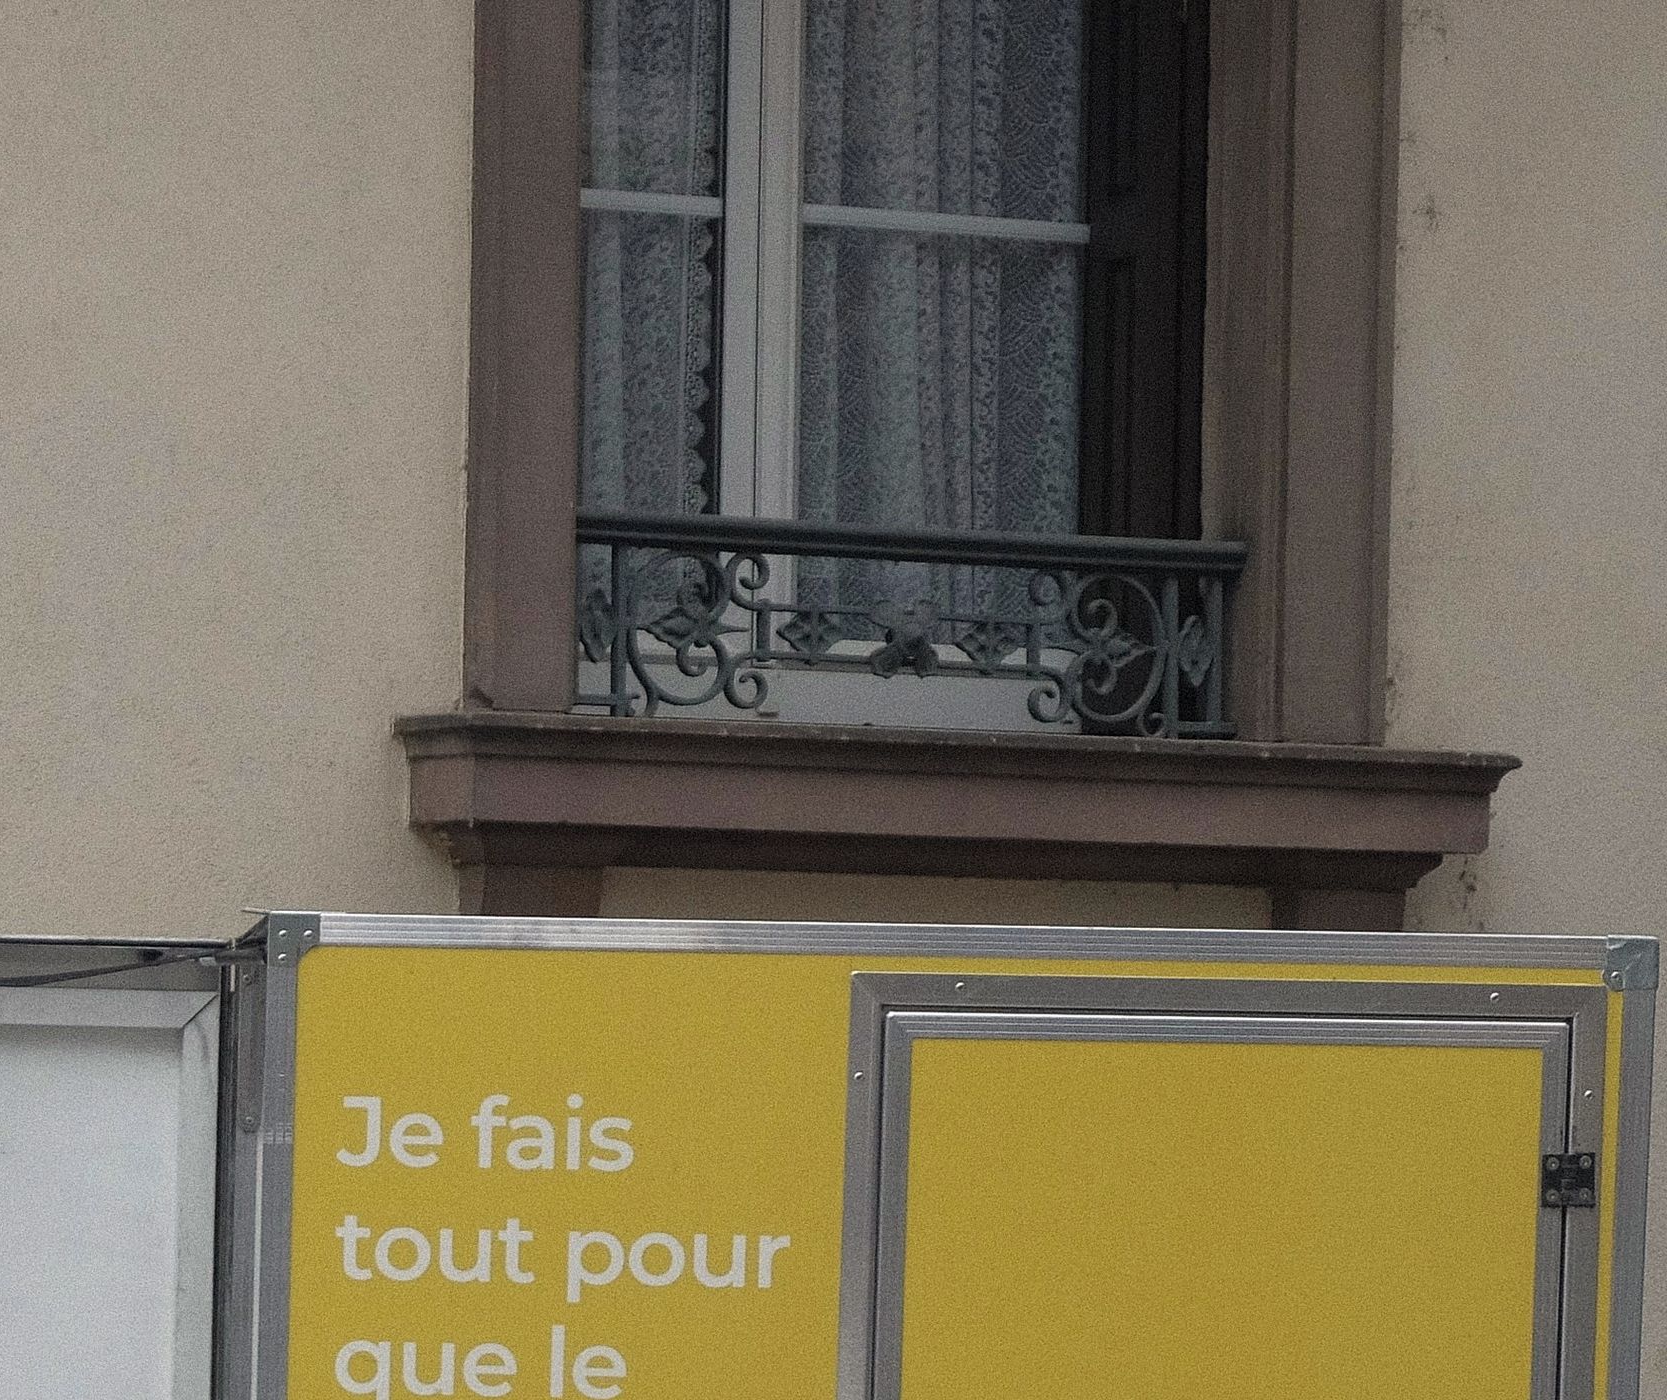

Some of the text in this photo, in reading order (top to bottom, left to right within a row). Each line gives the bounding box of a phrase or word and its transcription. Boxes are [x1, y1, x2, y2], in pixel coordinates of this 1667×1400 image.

[336, 1093, 634, 1173] Je fais
[335, 1213, 791, 1304] tout pour
[549, 1324, 628, 1400] le
